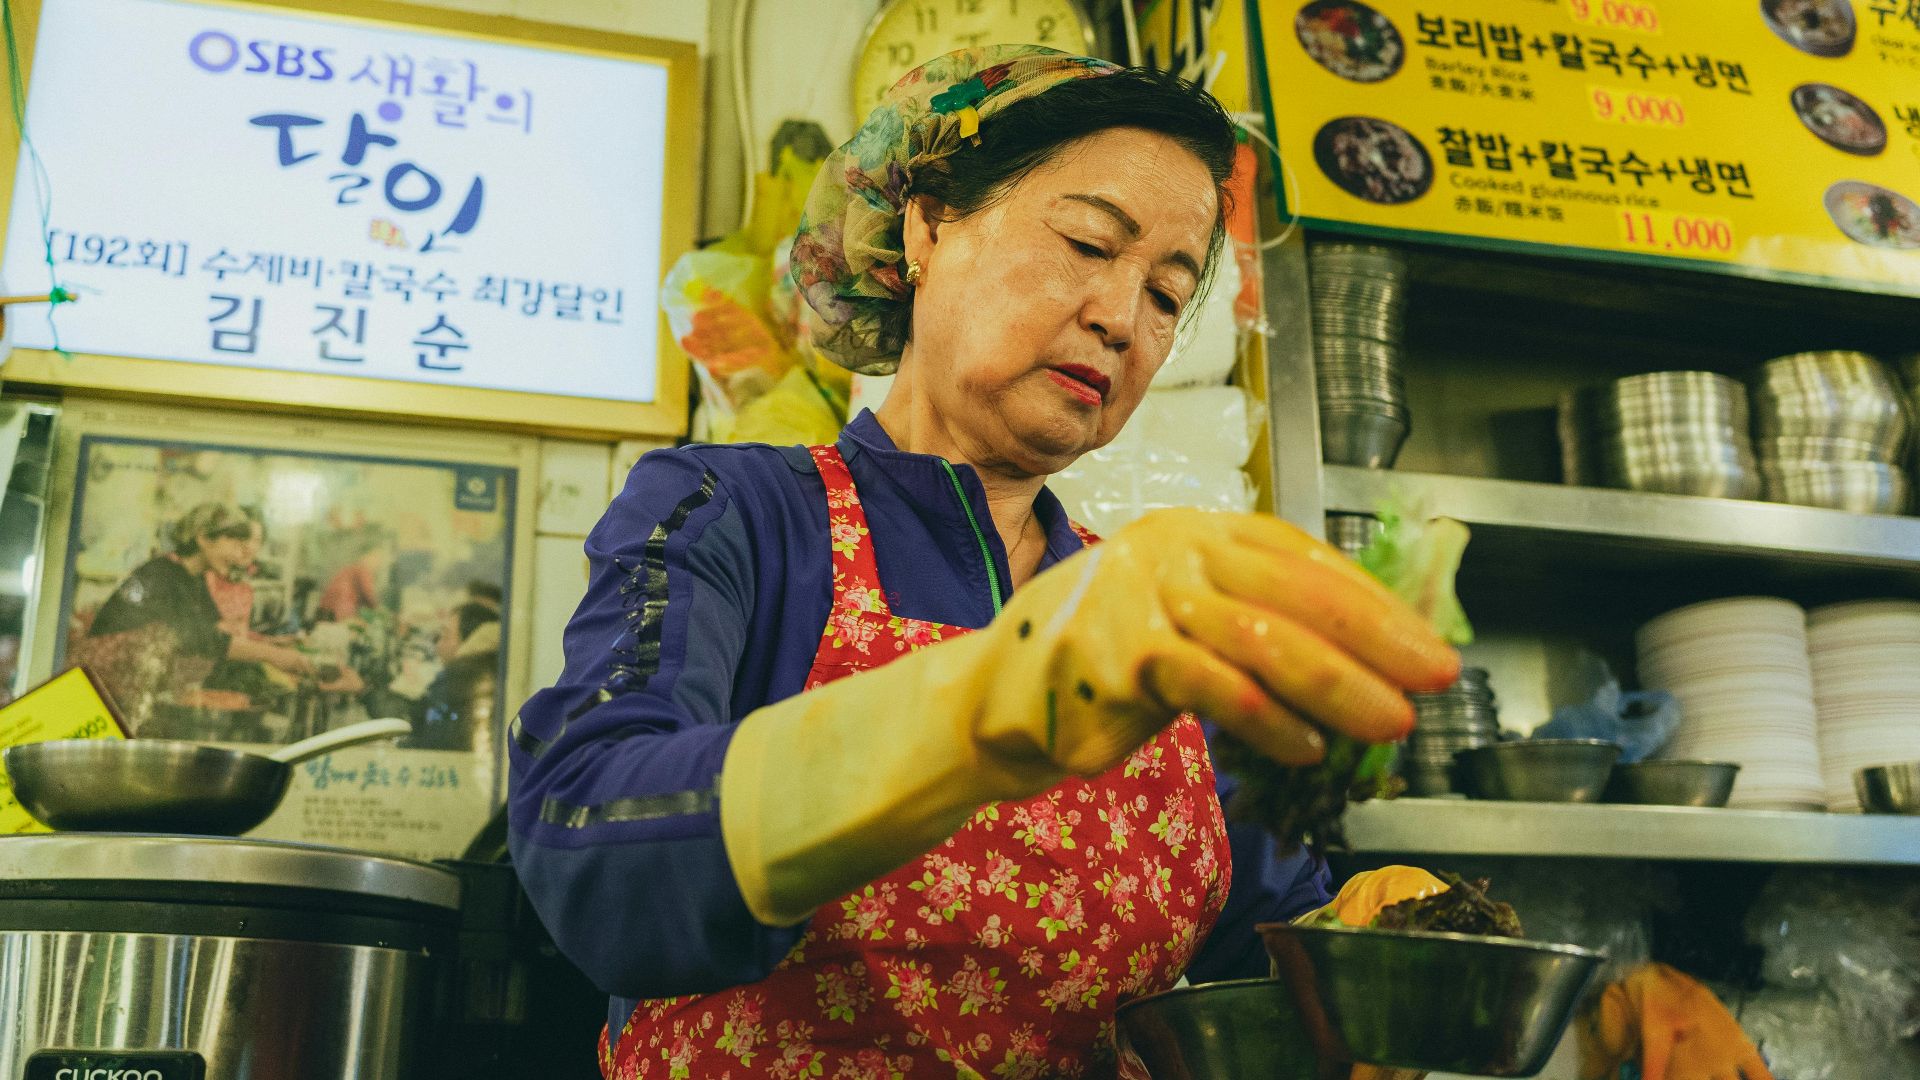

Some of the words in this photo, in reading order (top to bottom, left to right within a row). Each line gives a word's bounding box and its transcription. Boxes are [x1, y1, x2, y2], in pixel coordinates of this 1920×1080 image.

[915, 8, 938, 33] 11
[1415, 12, 1753, 96] 보리밥+칼국수+냉면
[244, 41, 335, 81] SBS
[350, 52, 533, 135] 생활의
[248, 112, 484, 253] 달인
[1437, 127, 1755, 200] 찰밥+칼국수+냉면
[1449, 172, 1525, 195] Cooked
[48, 229, 190, 277] [192회]
[473, 275, 624, 325] 최강달인
